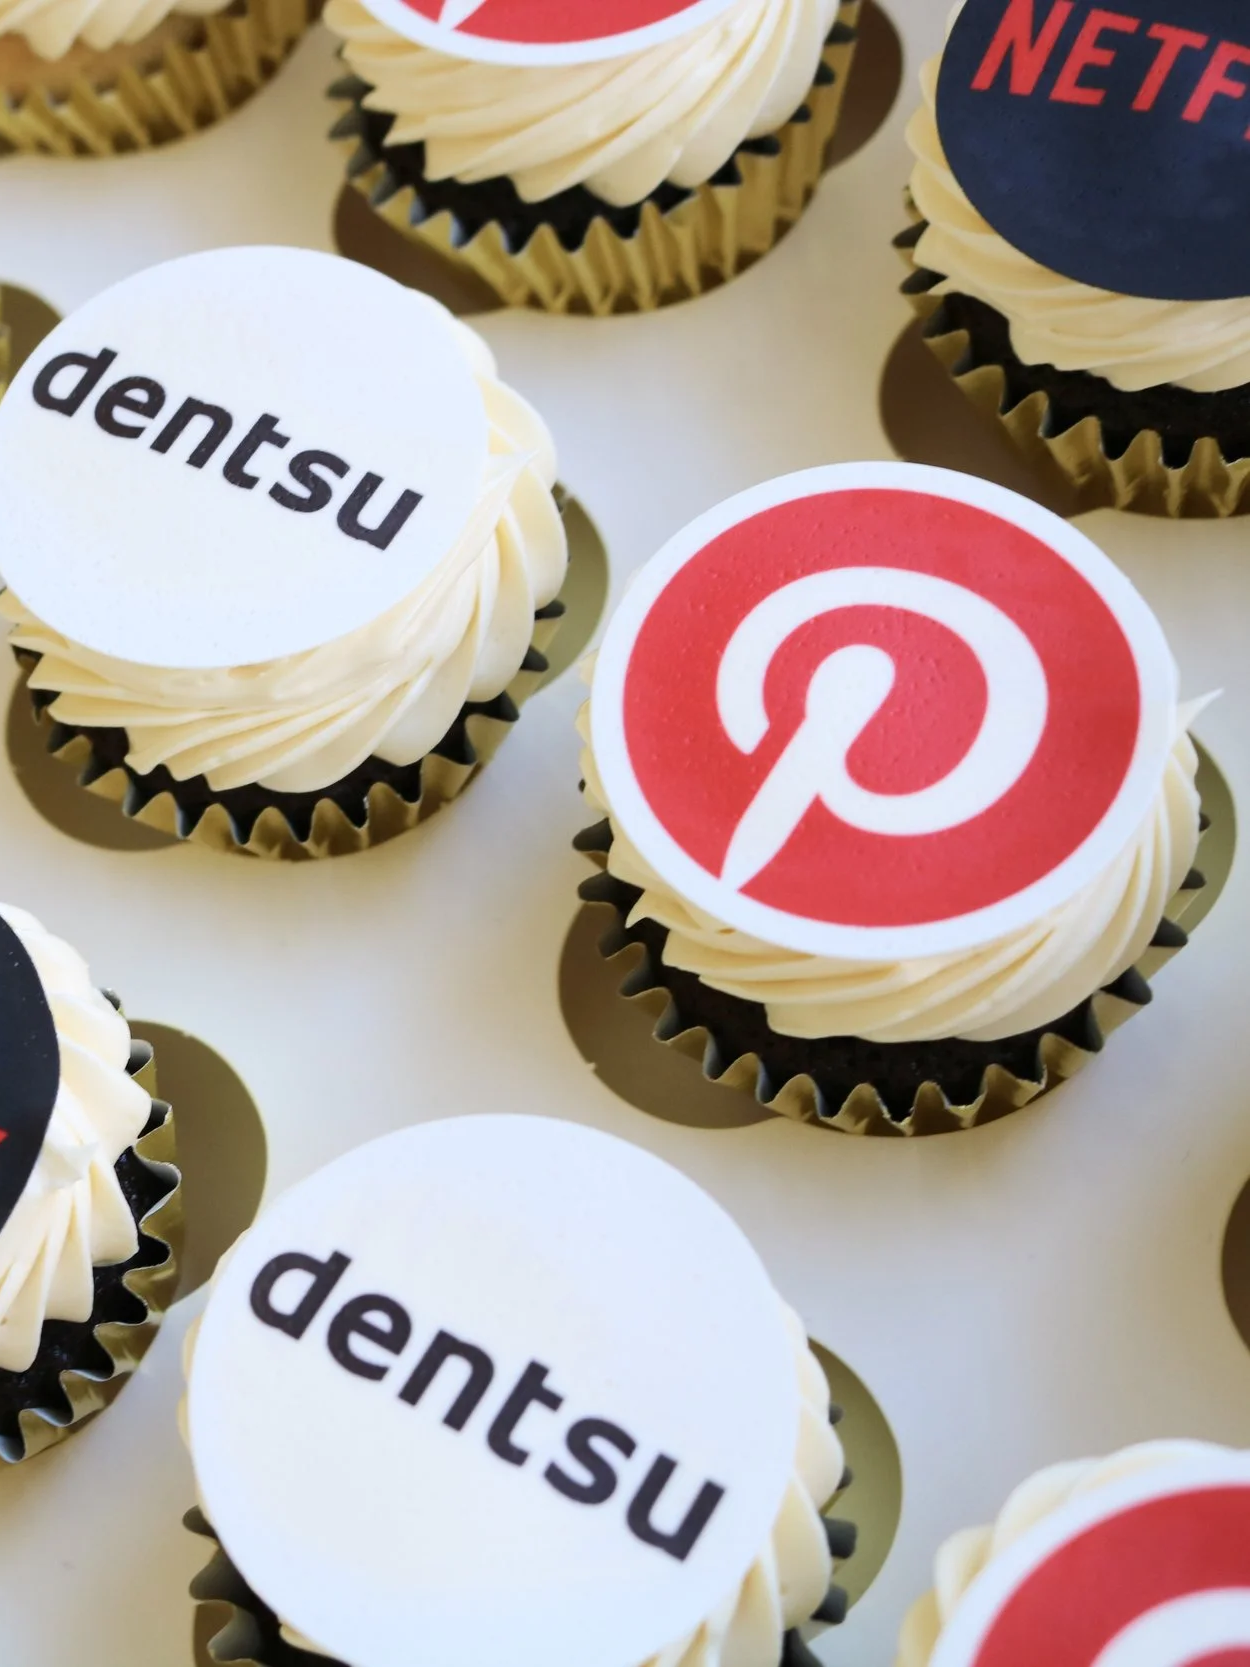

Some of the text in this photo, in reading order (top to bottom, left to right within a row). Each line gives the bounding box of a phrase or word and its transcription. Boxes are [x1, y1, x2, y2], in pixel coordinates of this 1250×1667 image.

[970, 0, 1250, 141] NETF
[32, 346, 424, 552] dentsu
[248, 1250, 726, 1563] dentsu
